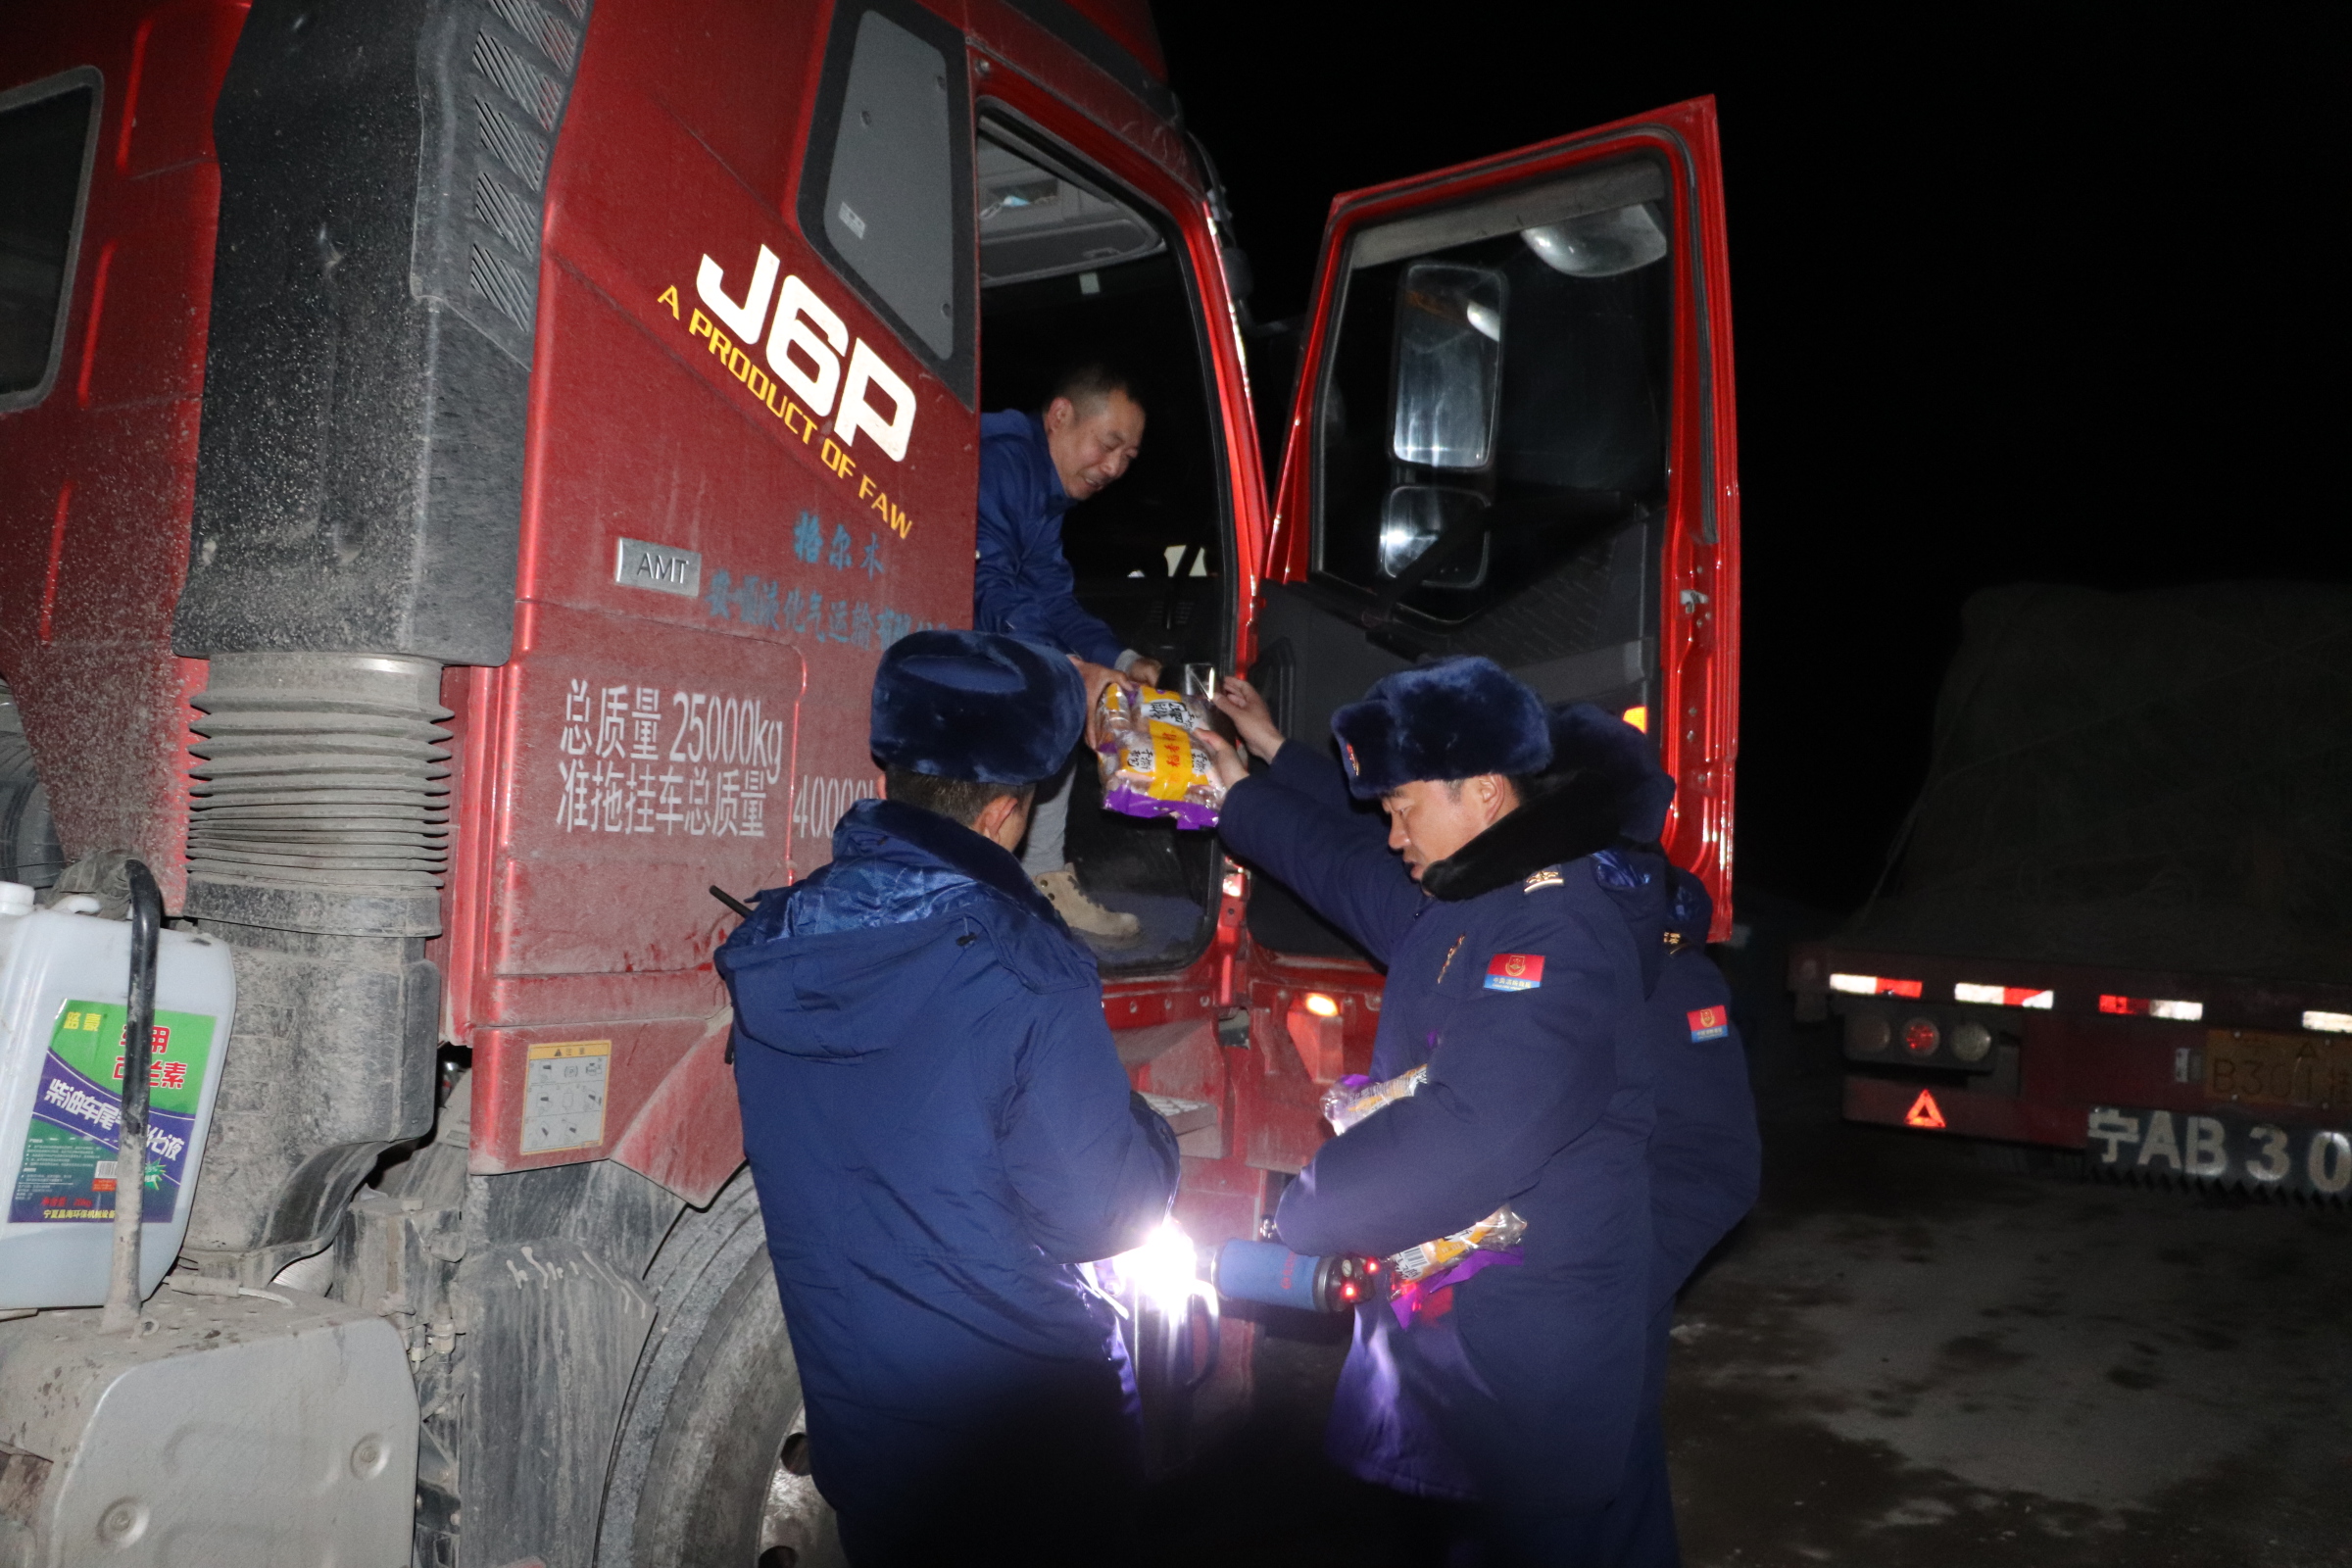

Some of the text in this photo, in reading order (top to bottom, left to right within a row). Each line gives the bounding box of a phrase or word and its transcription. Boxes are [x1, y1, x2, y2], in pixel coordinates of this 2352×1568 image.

[696, 243, 916, 463] J6P
[657, 284, 913, 539] A PRODUCT OF FAW
[636, 551, 690, 584] AMT
[559, 677, 784, 784] 总质量 25000kg
[556, 758, 768, 838] 准拖挂车总质量
